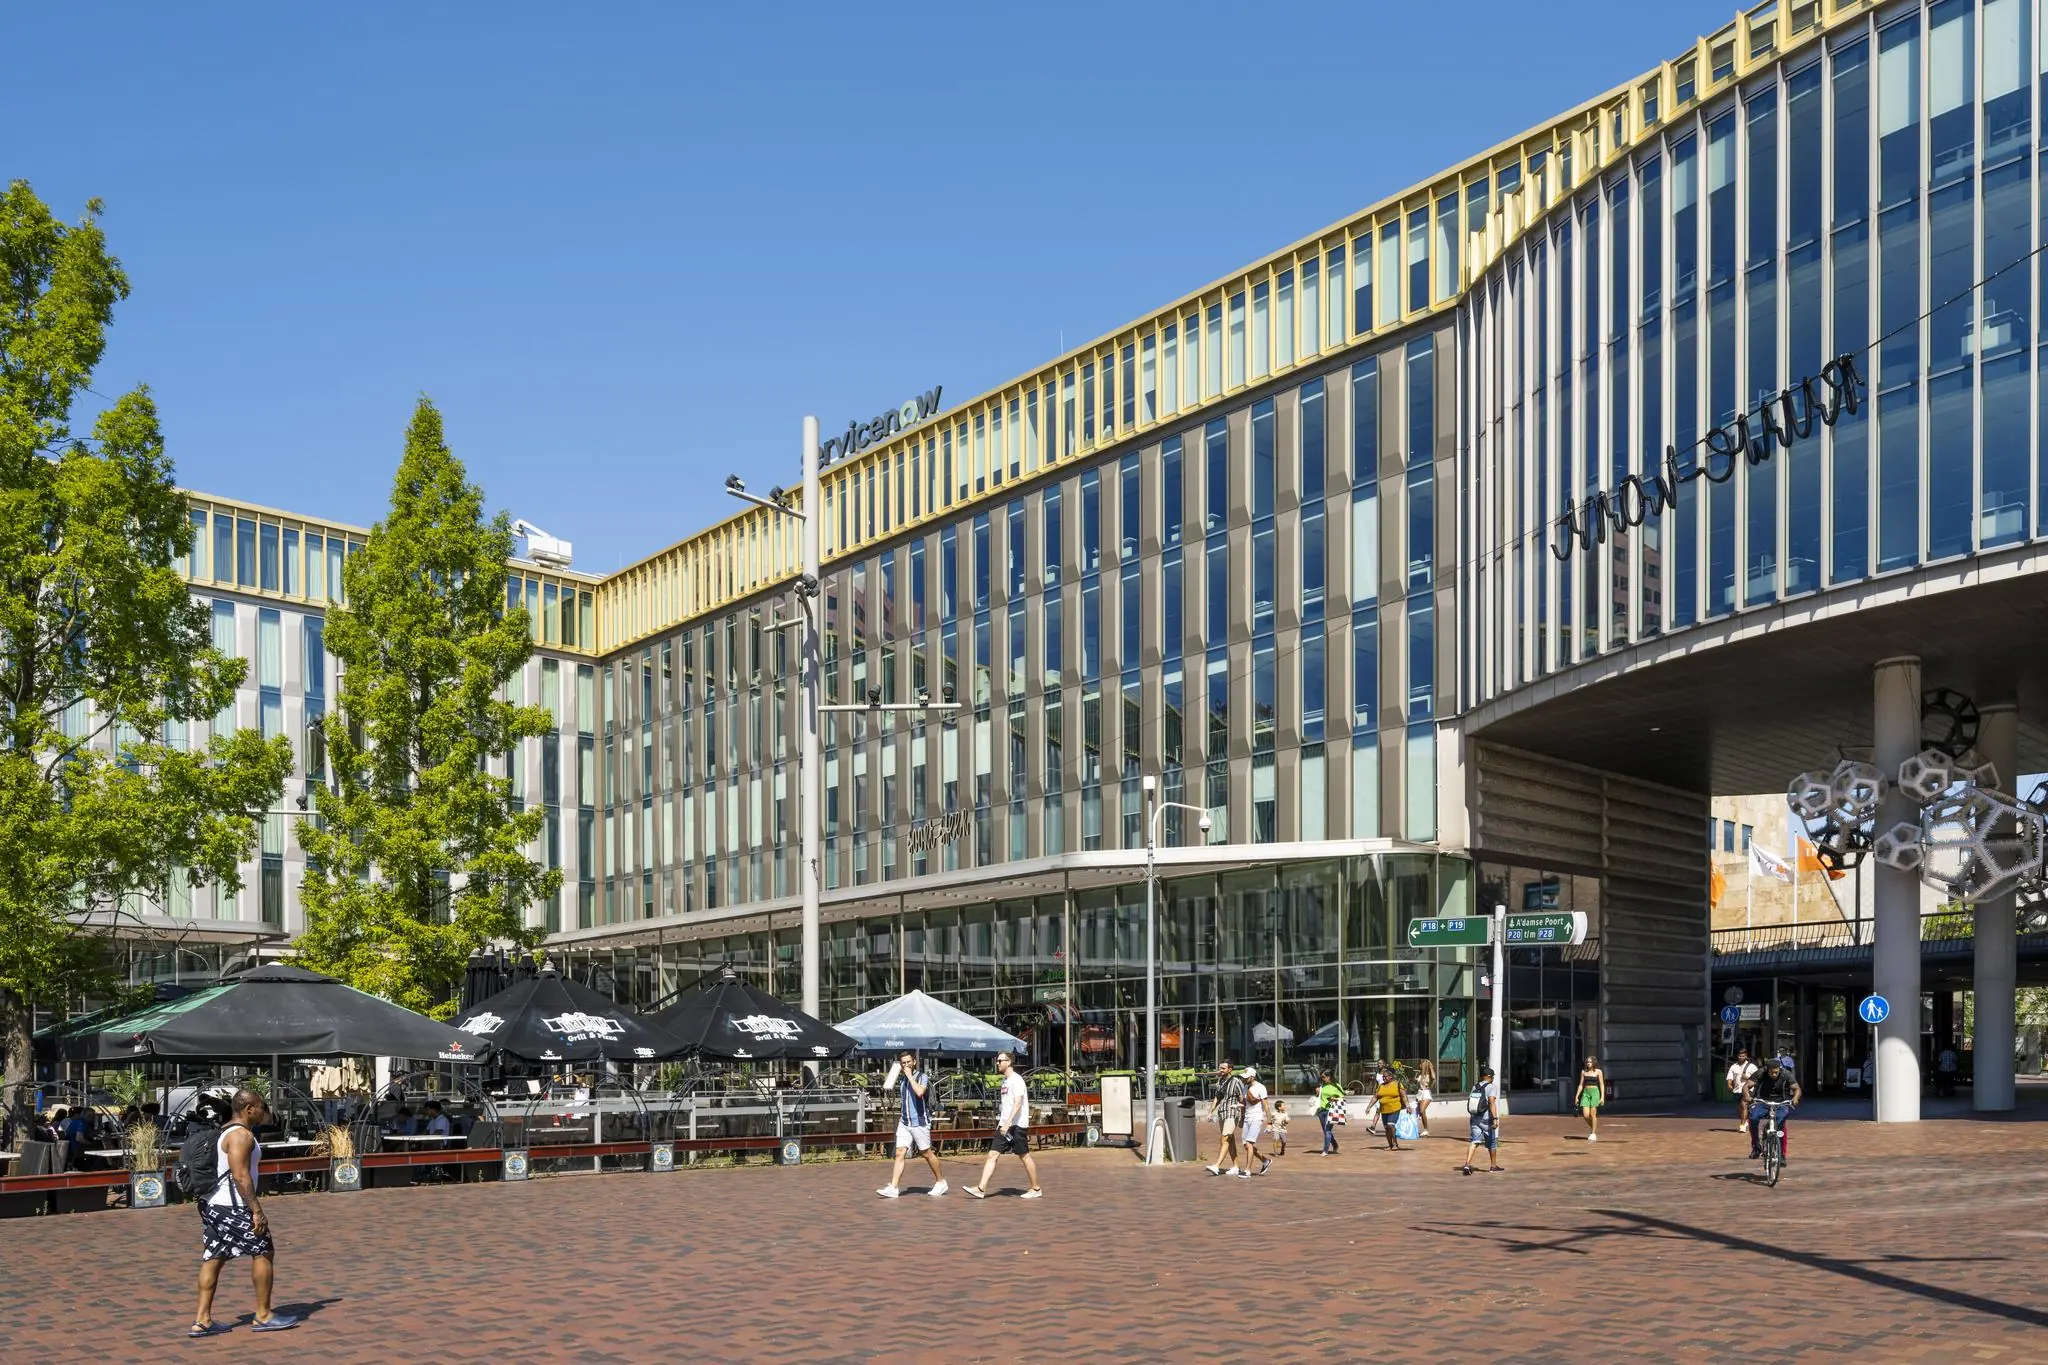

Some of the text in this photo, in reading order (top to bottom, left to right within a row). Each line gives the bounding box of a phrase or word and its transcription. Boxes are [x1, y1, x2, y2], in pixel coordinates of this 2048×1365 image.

[1422, 921, 1437, 931] P18
[1449, 920, 1464, 930] P19
[1516, 917, 1564, 928] A'damse Poort
[1523, 931, 1536, 939] t/m
[1538, 930, 1553, 939] P28
[567, 1031, 619, 1042] Grill & Pizza
[755, 1033, 773, 1042] Grill
[438, 1051, 475, 1061] Heineken
